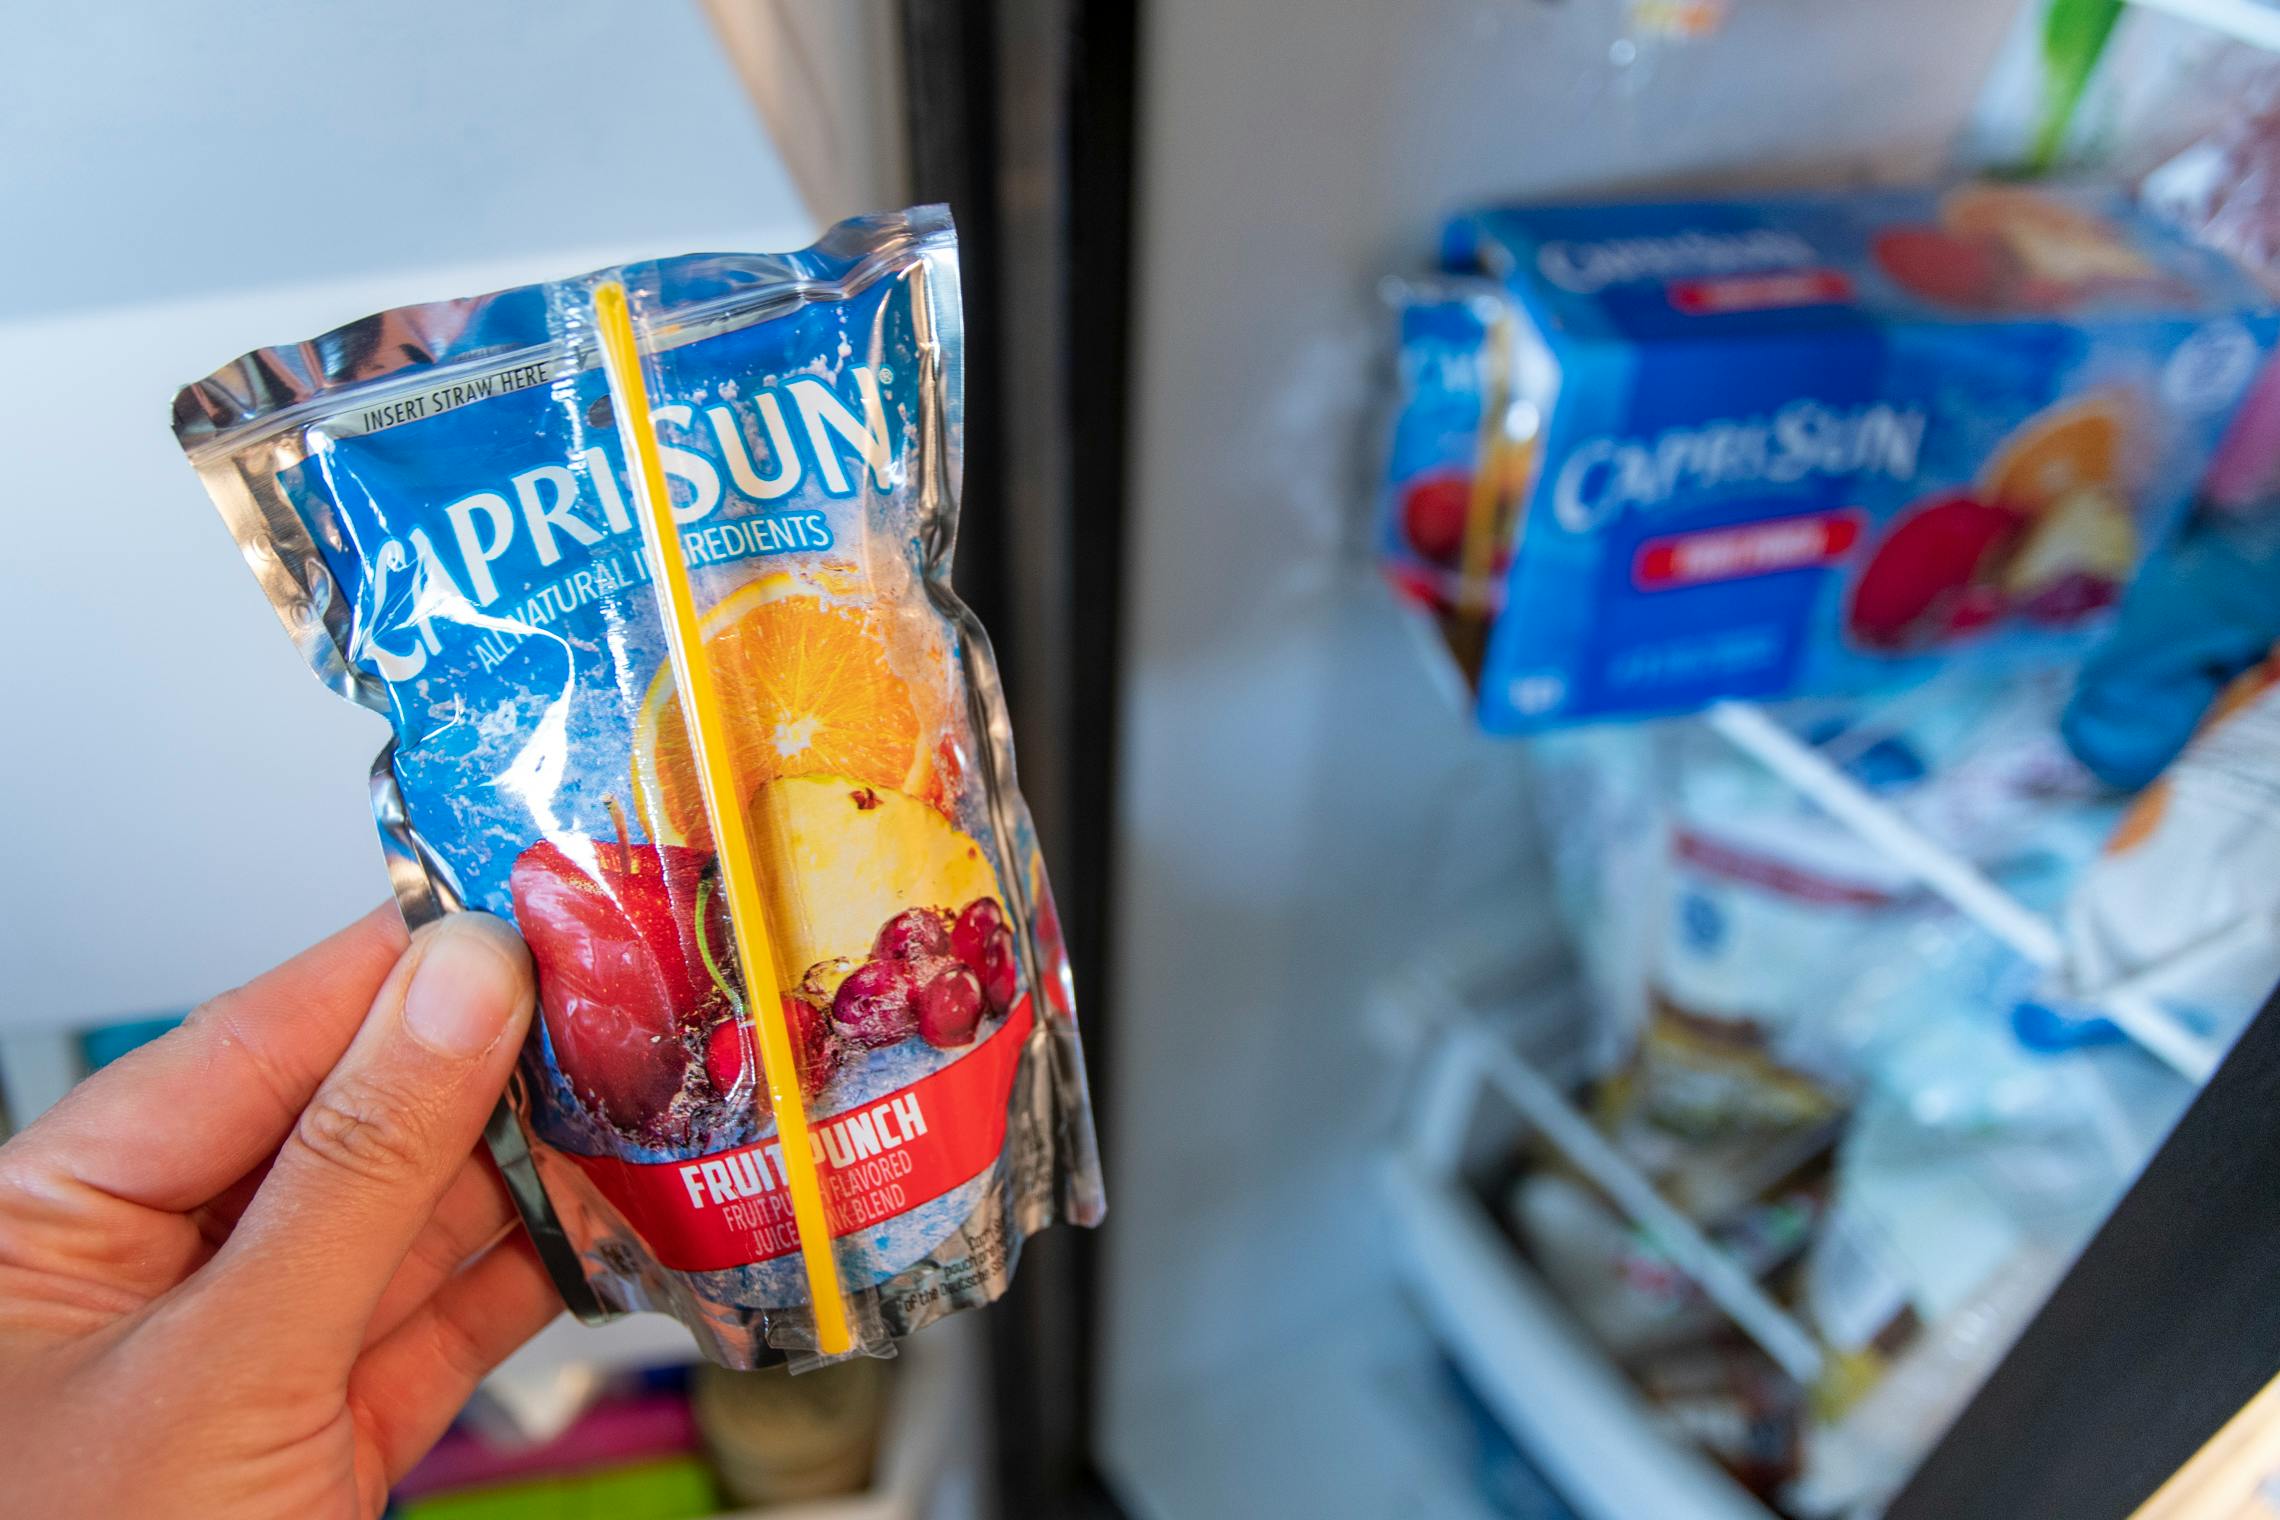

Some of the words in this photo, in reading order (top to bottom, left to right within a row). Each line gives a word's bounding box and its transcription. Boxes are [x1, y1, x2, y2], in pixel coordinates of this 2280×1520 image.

[364, 397, 427, 432] INSERT
[432, 376, 494, 412] STRAW
[500, 361, 550, 393] HERE
[475, 627, 515, 674] ALL
[638, 515, 829, 580] IREDIENTS
[722, 1196, 772, 1232] FRUIT
[830, 1150, 912, 1203] FLAVORED
[753, 1220, 800, 1256] JUICE
[852, 1184, 905, 1223] BLEND
